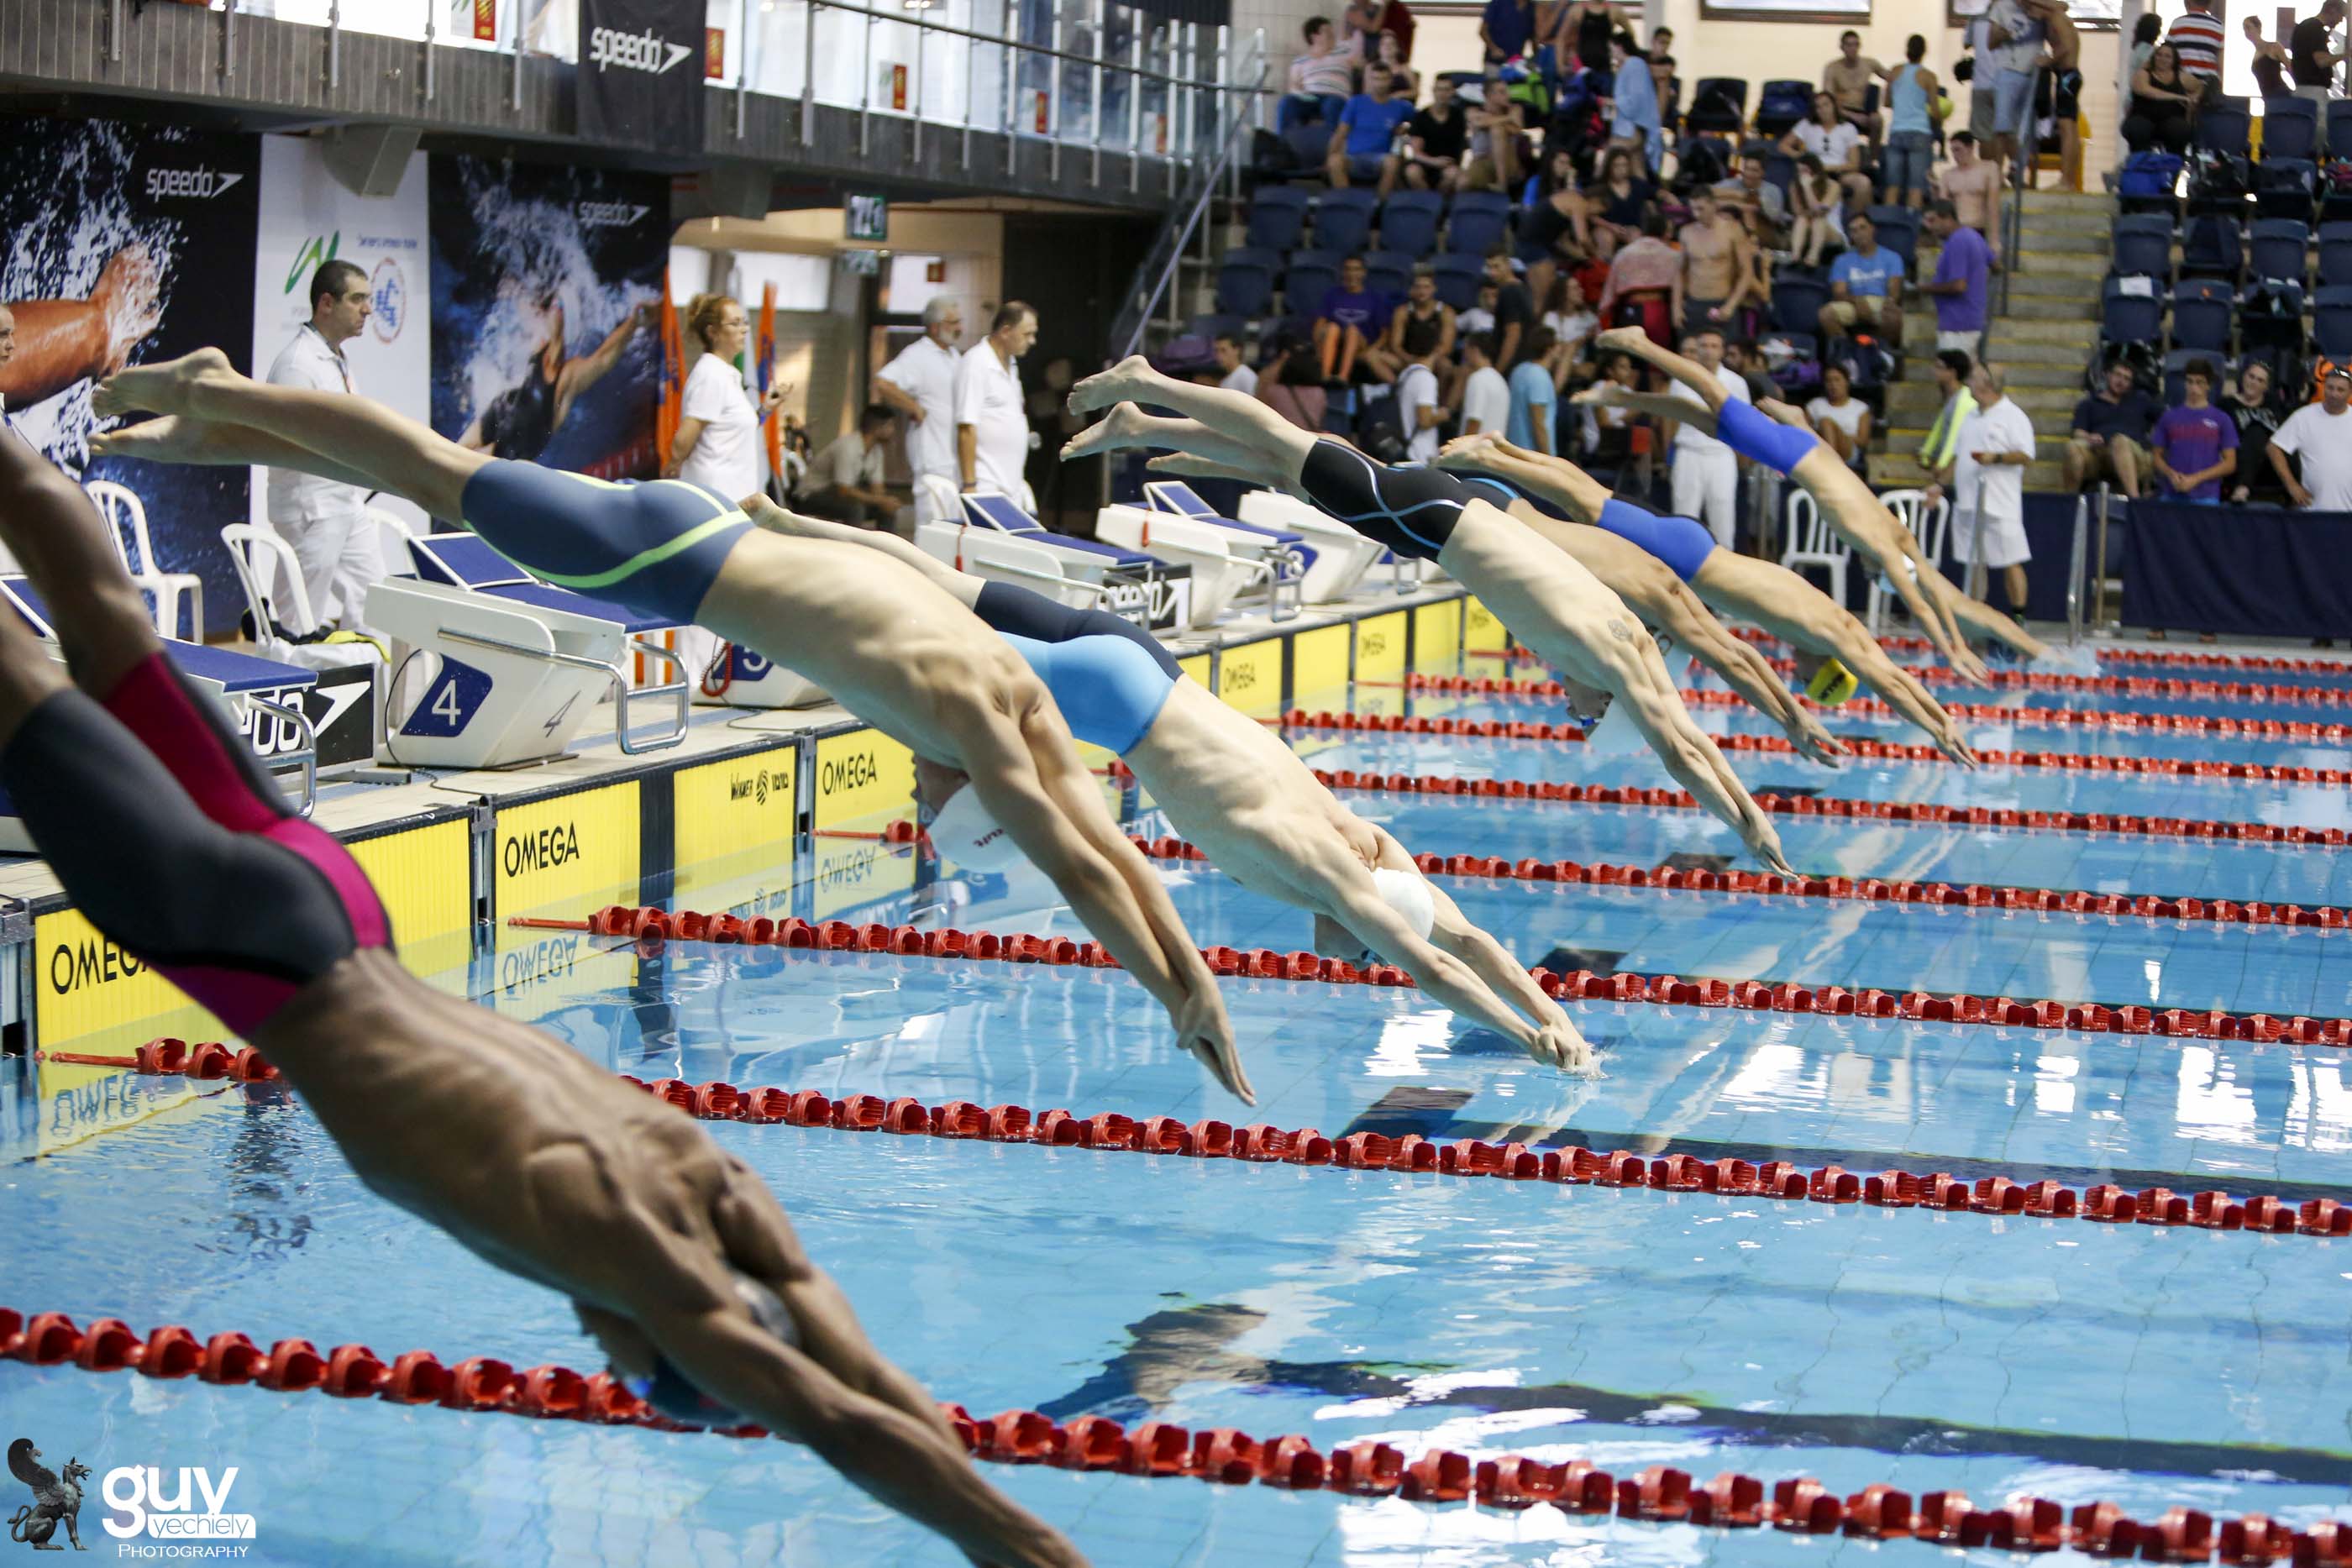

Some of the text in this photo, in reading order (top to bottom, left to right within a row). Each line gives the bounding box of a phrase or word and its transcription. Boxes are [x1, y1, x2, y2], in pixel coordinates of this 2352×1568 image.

[588, 26, 662, 73] speedo
[145, 162, 214, 203] speedo
[432, 679, 462, 726] 4
[822, 748, 877, 795] OMEGA
[504, 820, 580, 878] OMEGA
[51, 936, 147, 994] OMEG
